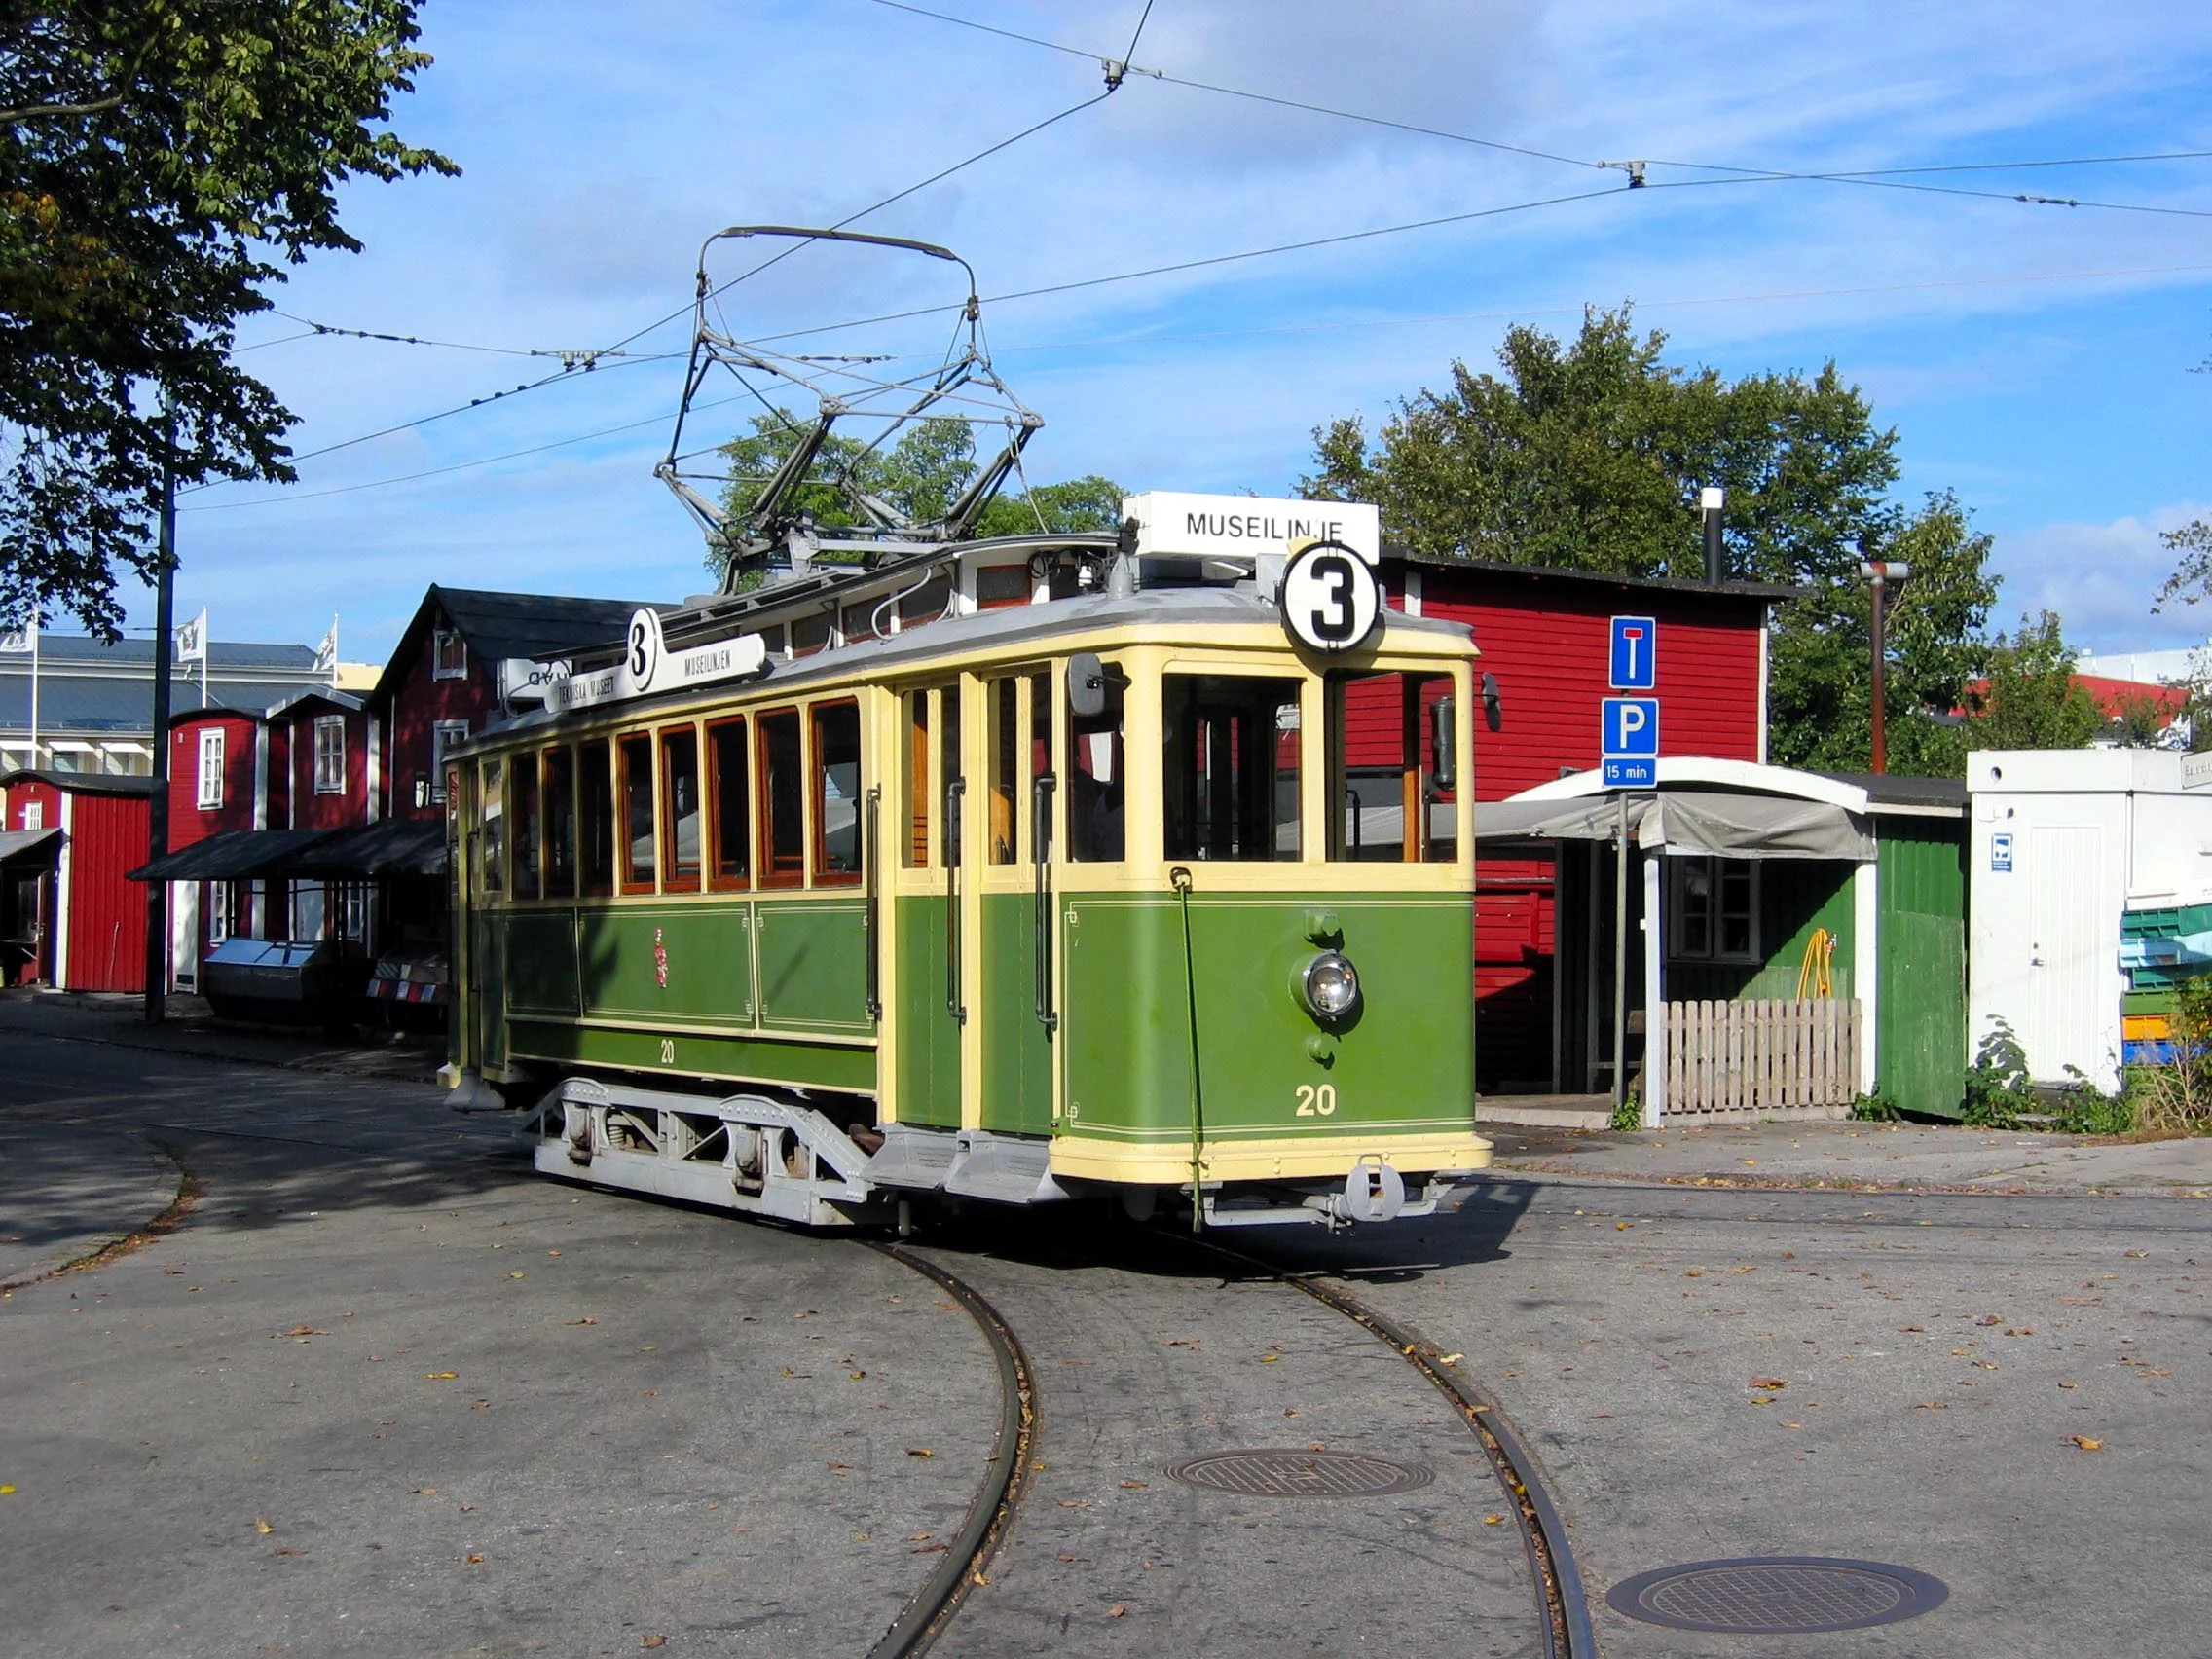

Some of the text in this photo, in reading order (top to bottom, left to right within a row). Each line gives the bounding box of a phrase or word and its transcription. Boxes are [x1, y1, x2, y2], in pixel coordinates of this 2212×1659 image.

[1187, 512, 1343, 542] MUSEILINJE
[1310, 556, 1355, 641] 3
[631, 622, 646, 677] 3
[684, 649, 731, 678] MUSEILINJEN
[559, 676, 614, 704] TEKNISKA MUSEET
[1619, 704, 1645, 749] P
[1606, 764, 1647, 779] 15 min
[660, 1039, 675, 1064] 20
[1295, 1084, 1337, 1117] 20
